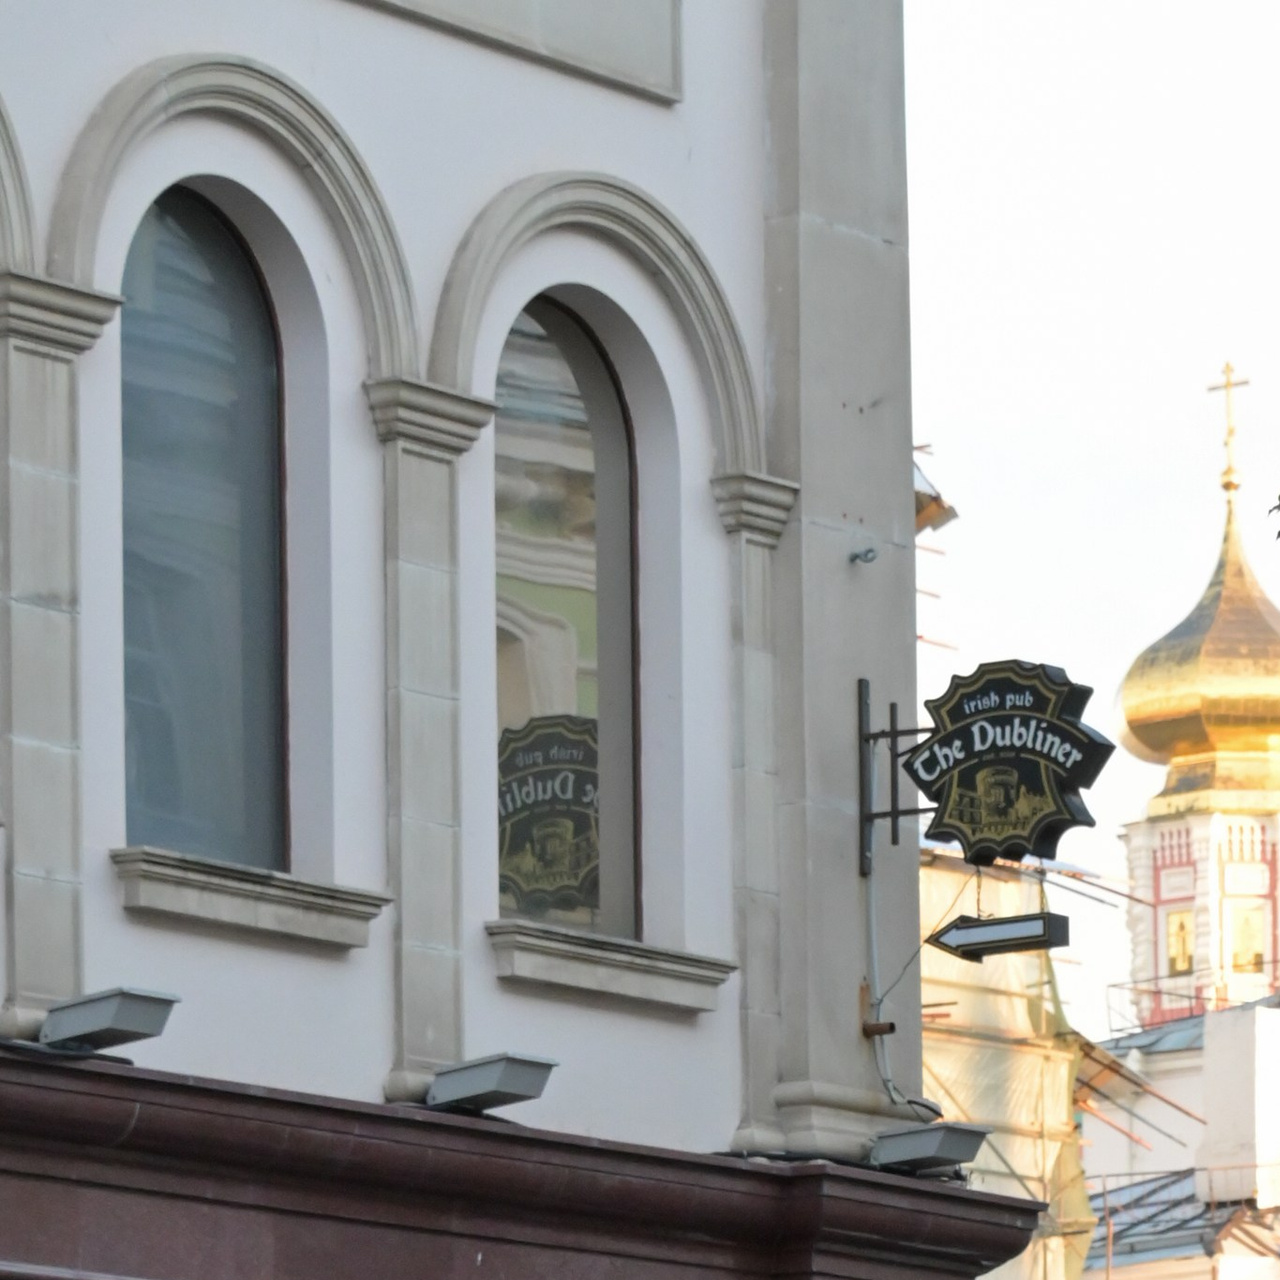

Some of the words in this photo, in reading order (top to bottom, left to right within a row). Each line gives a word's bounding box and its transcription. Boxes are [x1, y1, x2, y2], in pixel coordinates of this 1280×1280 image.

[963, 691, 1000, 715] irish
[1005, 691, 1034, 710] pub
[913, 743, 966, 782] The
[970, 716, 1083, 769] Dubliner
